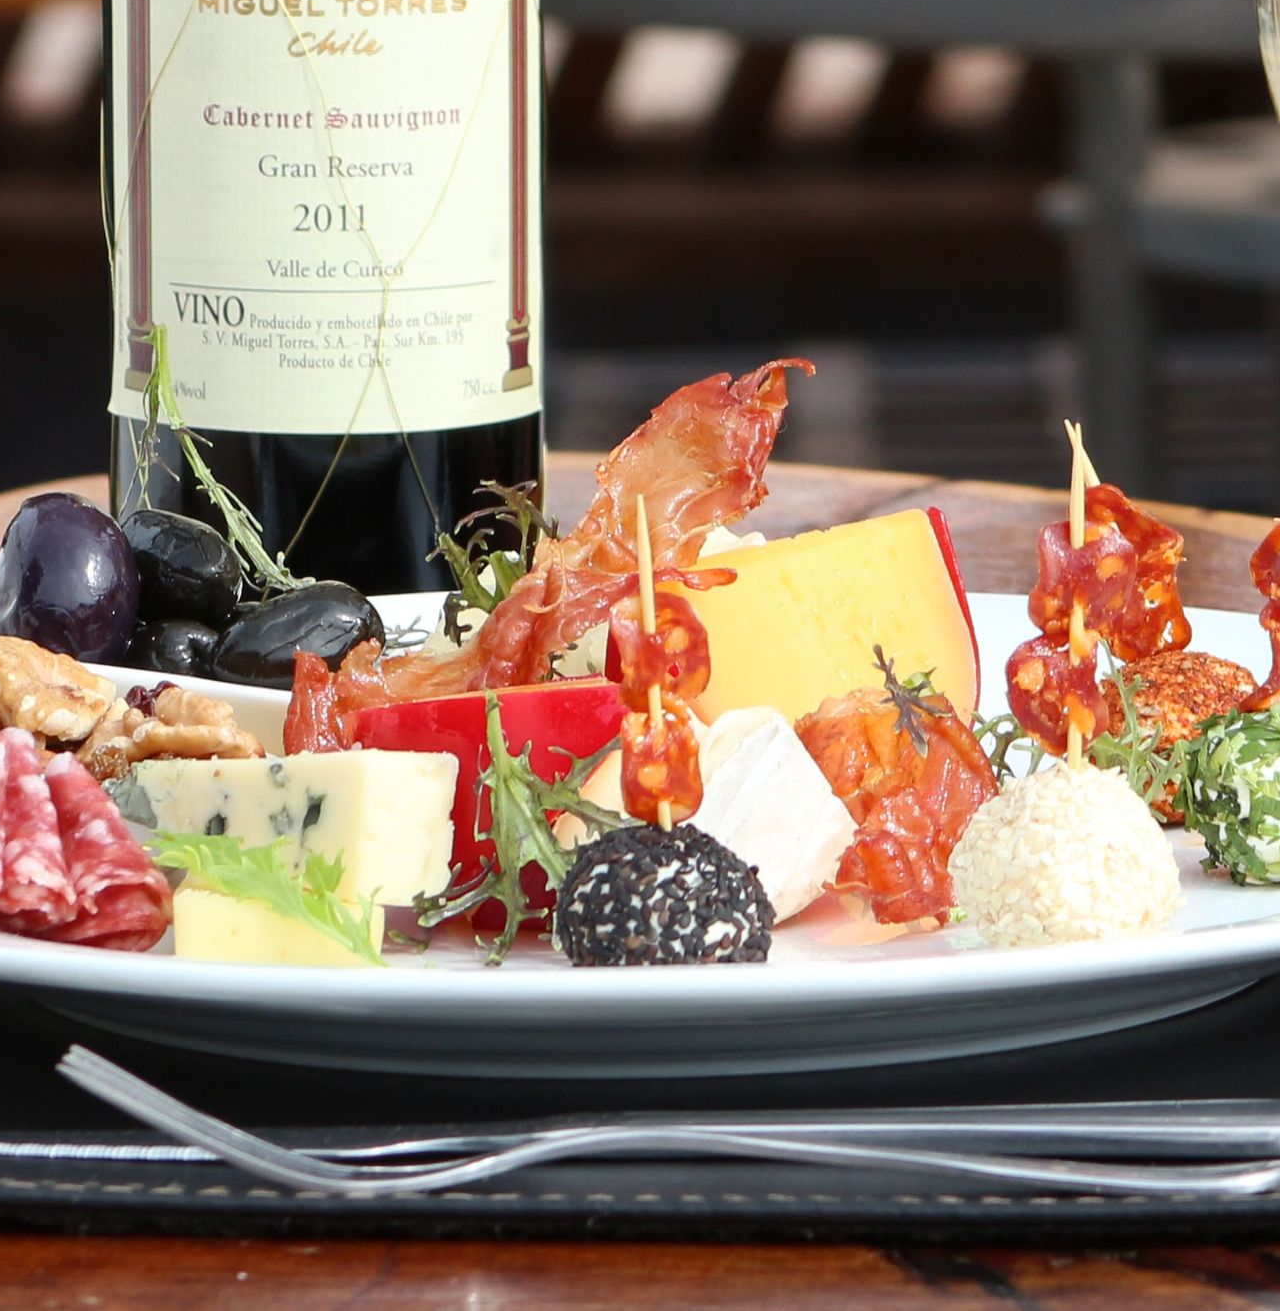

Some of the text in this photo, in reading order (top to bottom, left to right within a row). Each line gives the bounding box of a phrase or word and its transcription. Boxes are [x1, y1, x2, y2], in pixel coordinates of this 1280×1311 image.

[286, 28, 384, 58] Chile
[203, 104, 461, 131] Cabernet Sauvignon
[258, 154, 414, 178] Gran Reserva
[293, 203, 366, 232] 2011
[266, 259, 311, 278] Valle
[316, 260, 337, 278] de
[173, 291, 245, 327] VINO
[249, 313, 311, 330] Producido
[316, 318, 322, 333] y
[406, 316, 420, 328] en
[423, 311, 453, 326] Chile
[456, 312, 473, 328] por
[202, 330, 212, 346] S.
[216, 330, 227, 346] V.
[232, 331, 272, 352] Miguel
[277, 333, 319, 350] Torres,
[394, 333, 413, 348] Sur
[418, 331, 441, 346] Km.
[279, 353, 334, 369] Producto
[339, 354, 353, 368] de
